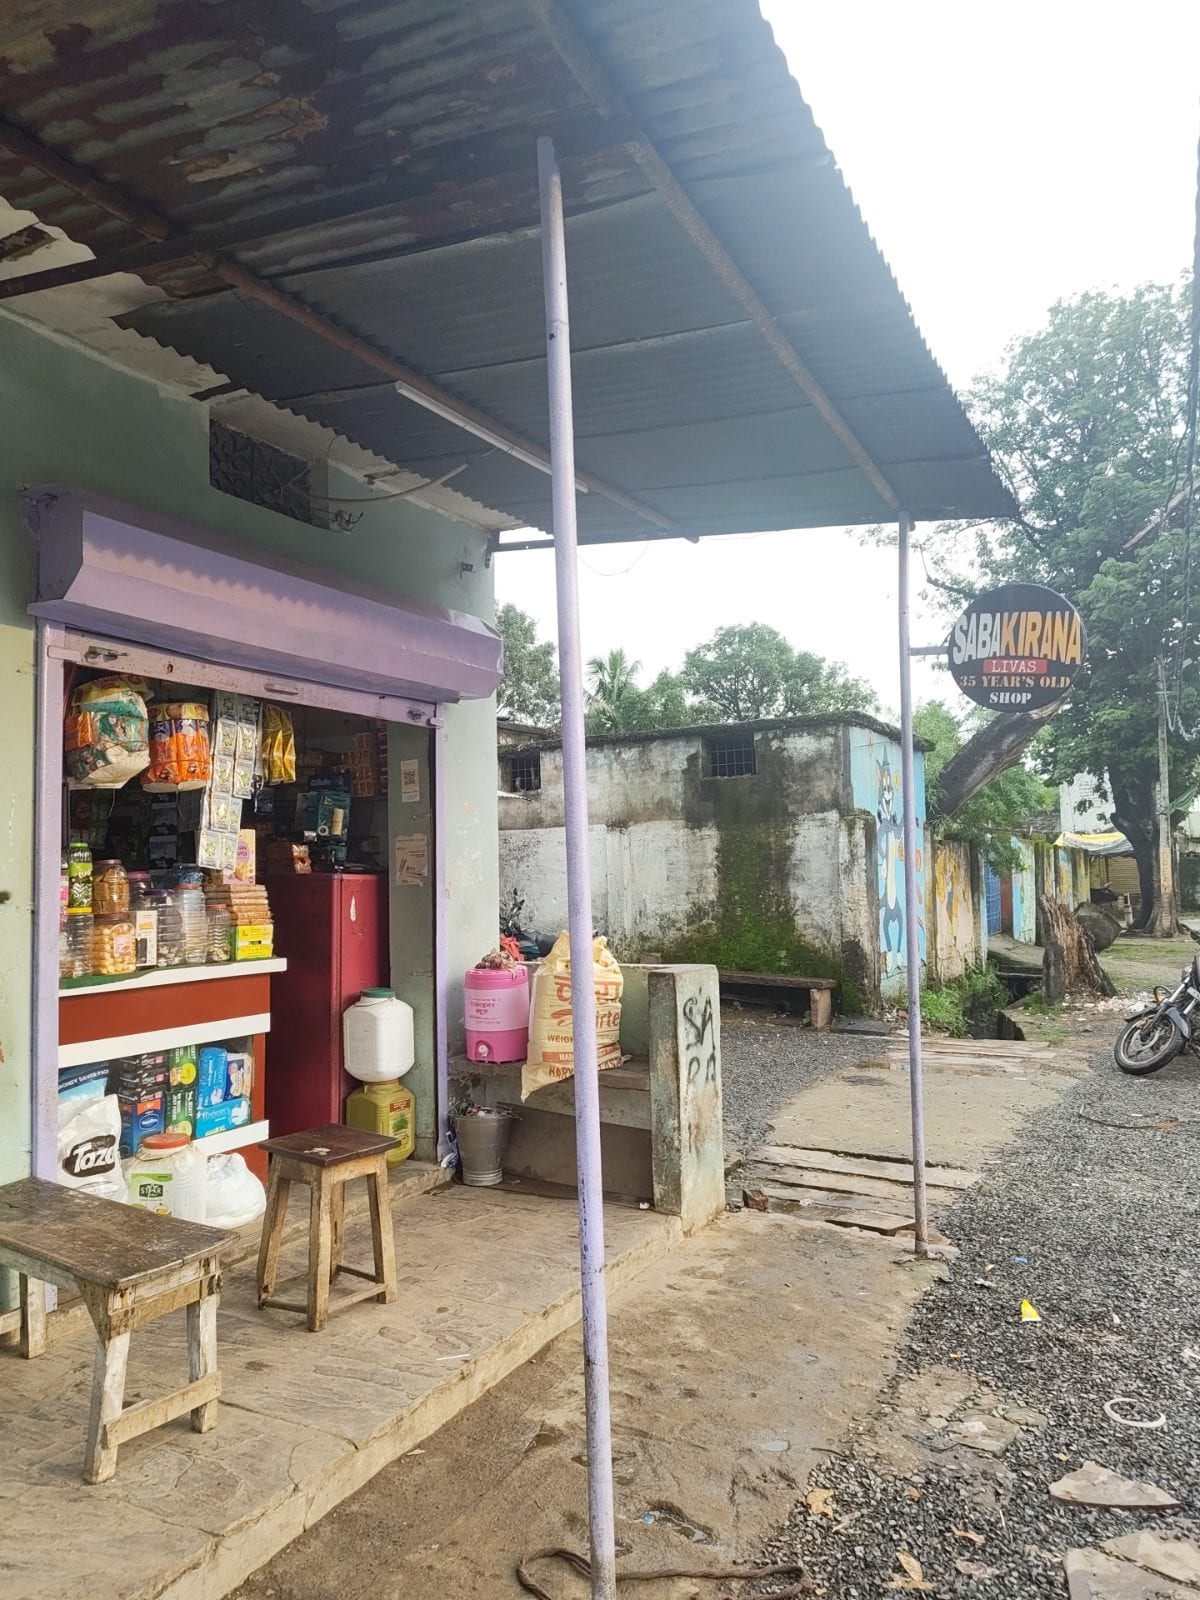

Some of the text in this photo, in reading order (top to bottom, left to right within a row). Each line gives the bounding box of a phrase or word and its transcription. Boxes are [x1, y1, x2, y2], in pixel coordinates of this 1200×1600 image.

[991, 660, 1037, 673] LIVAS
[959, 676, 1071, 688] 35 YEAR'S OLD
[989, 692, 1032, 704] SHOP
